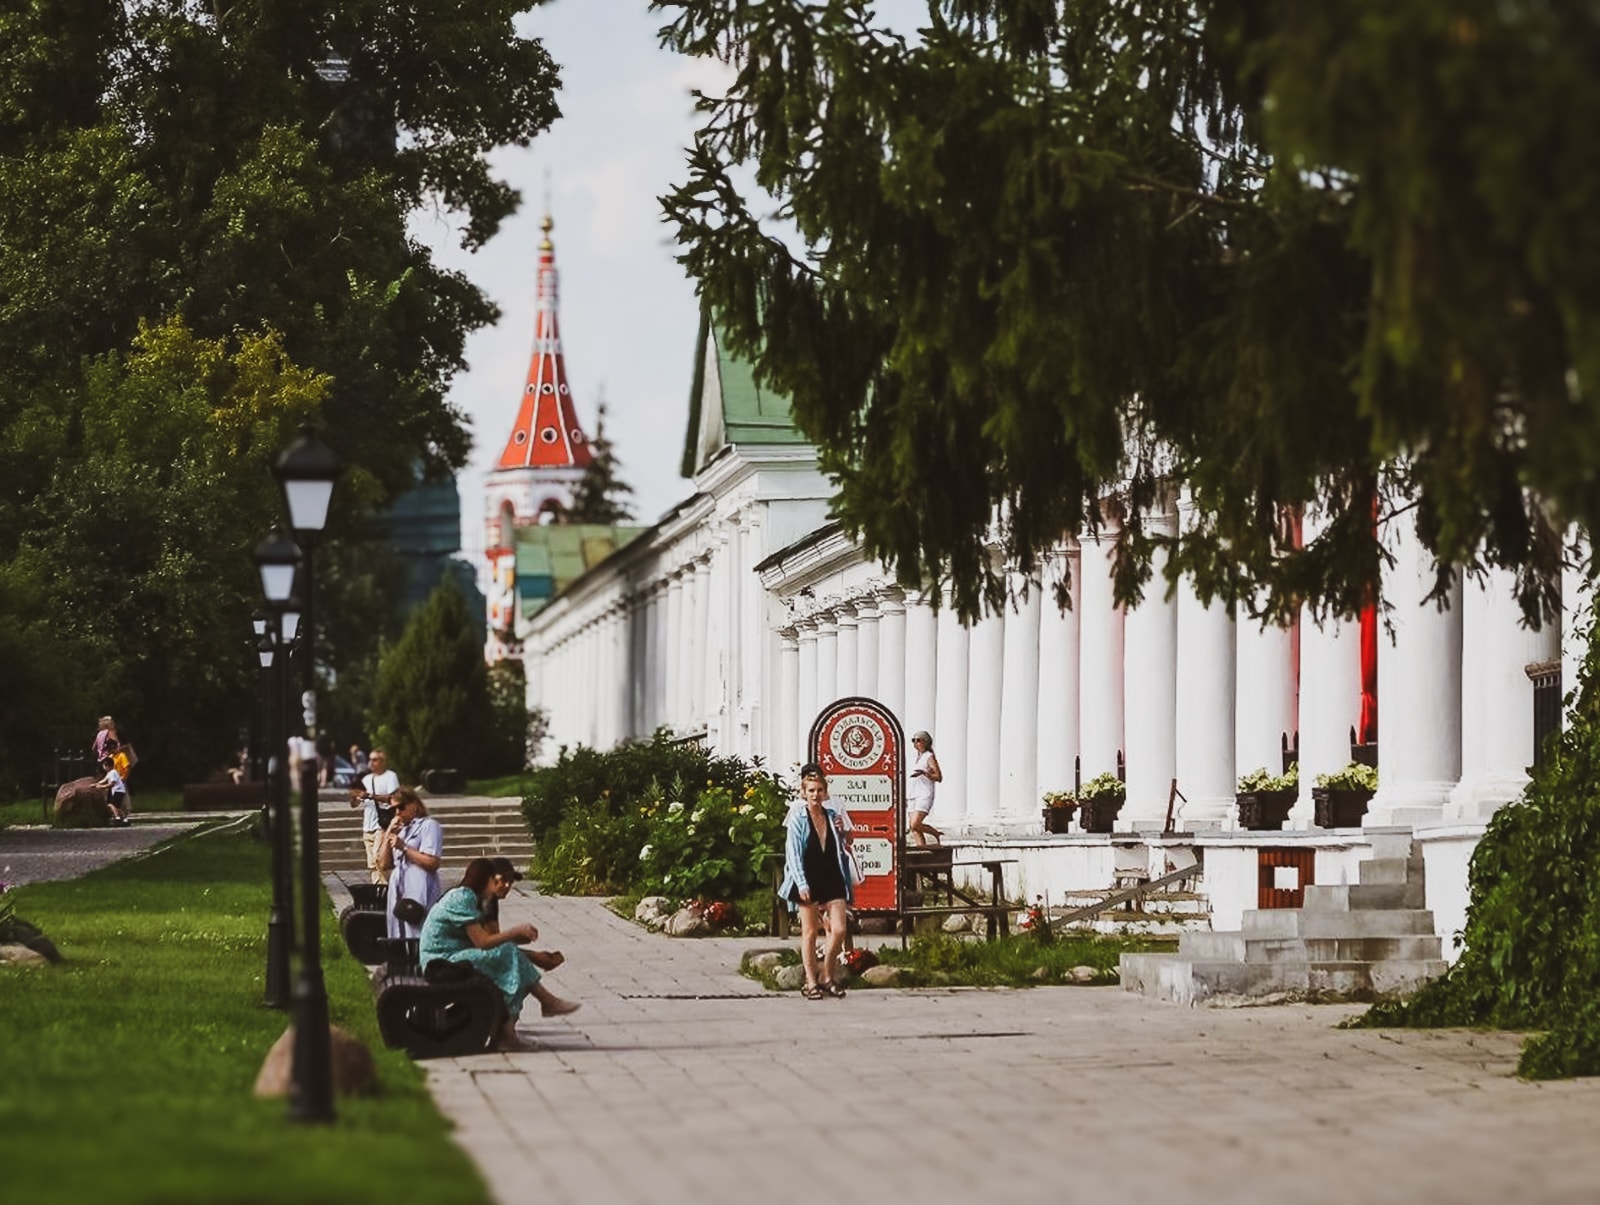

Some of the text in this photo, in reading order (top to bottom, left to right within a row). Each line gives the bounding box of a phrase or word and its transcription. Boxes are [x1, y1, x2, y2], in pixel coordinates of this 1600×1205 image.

[847, 780, 867, 789] ЗАЛ
[853, 844, 872, 853] АФЕ
[861, 861, 881, 871] ров
